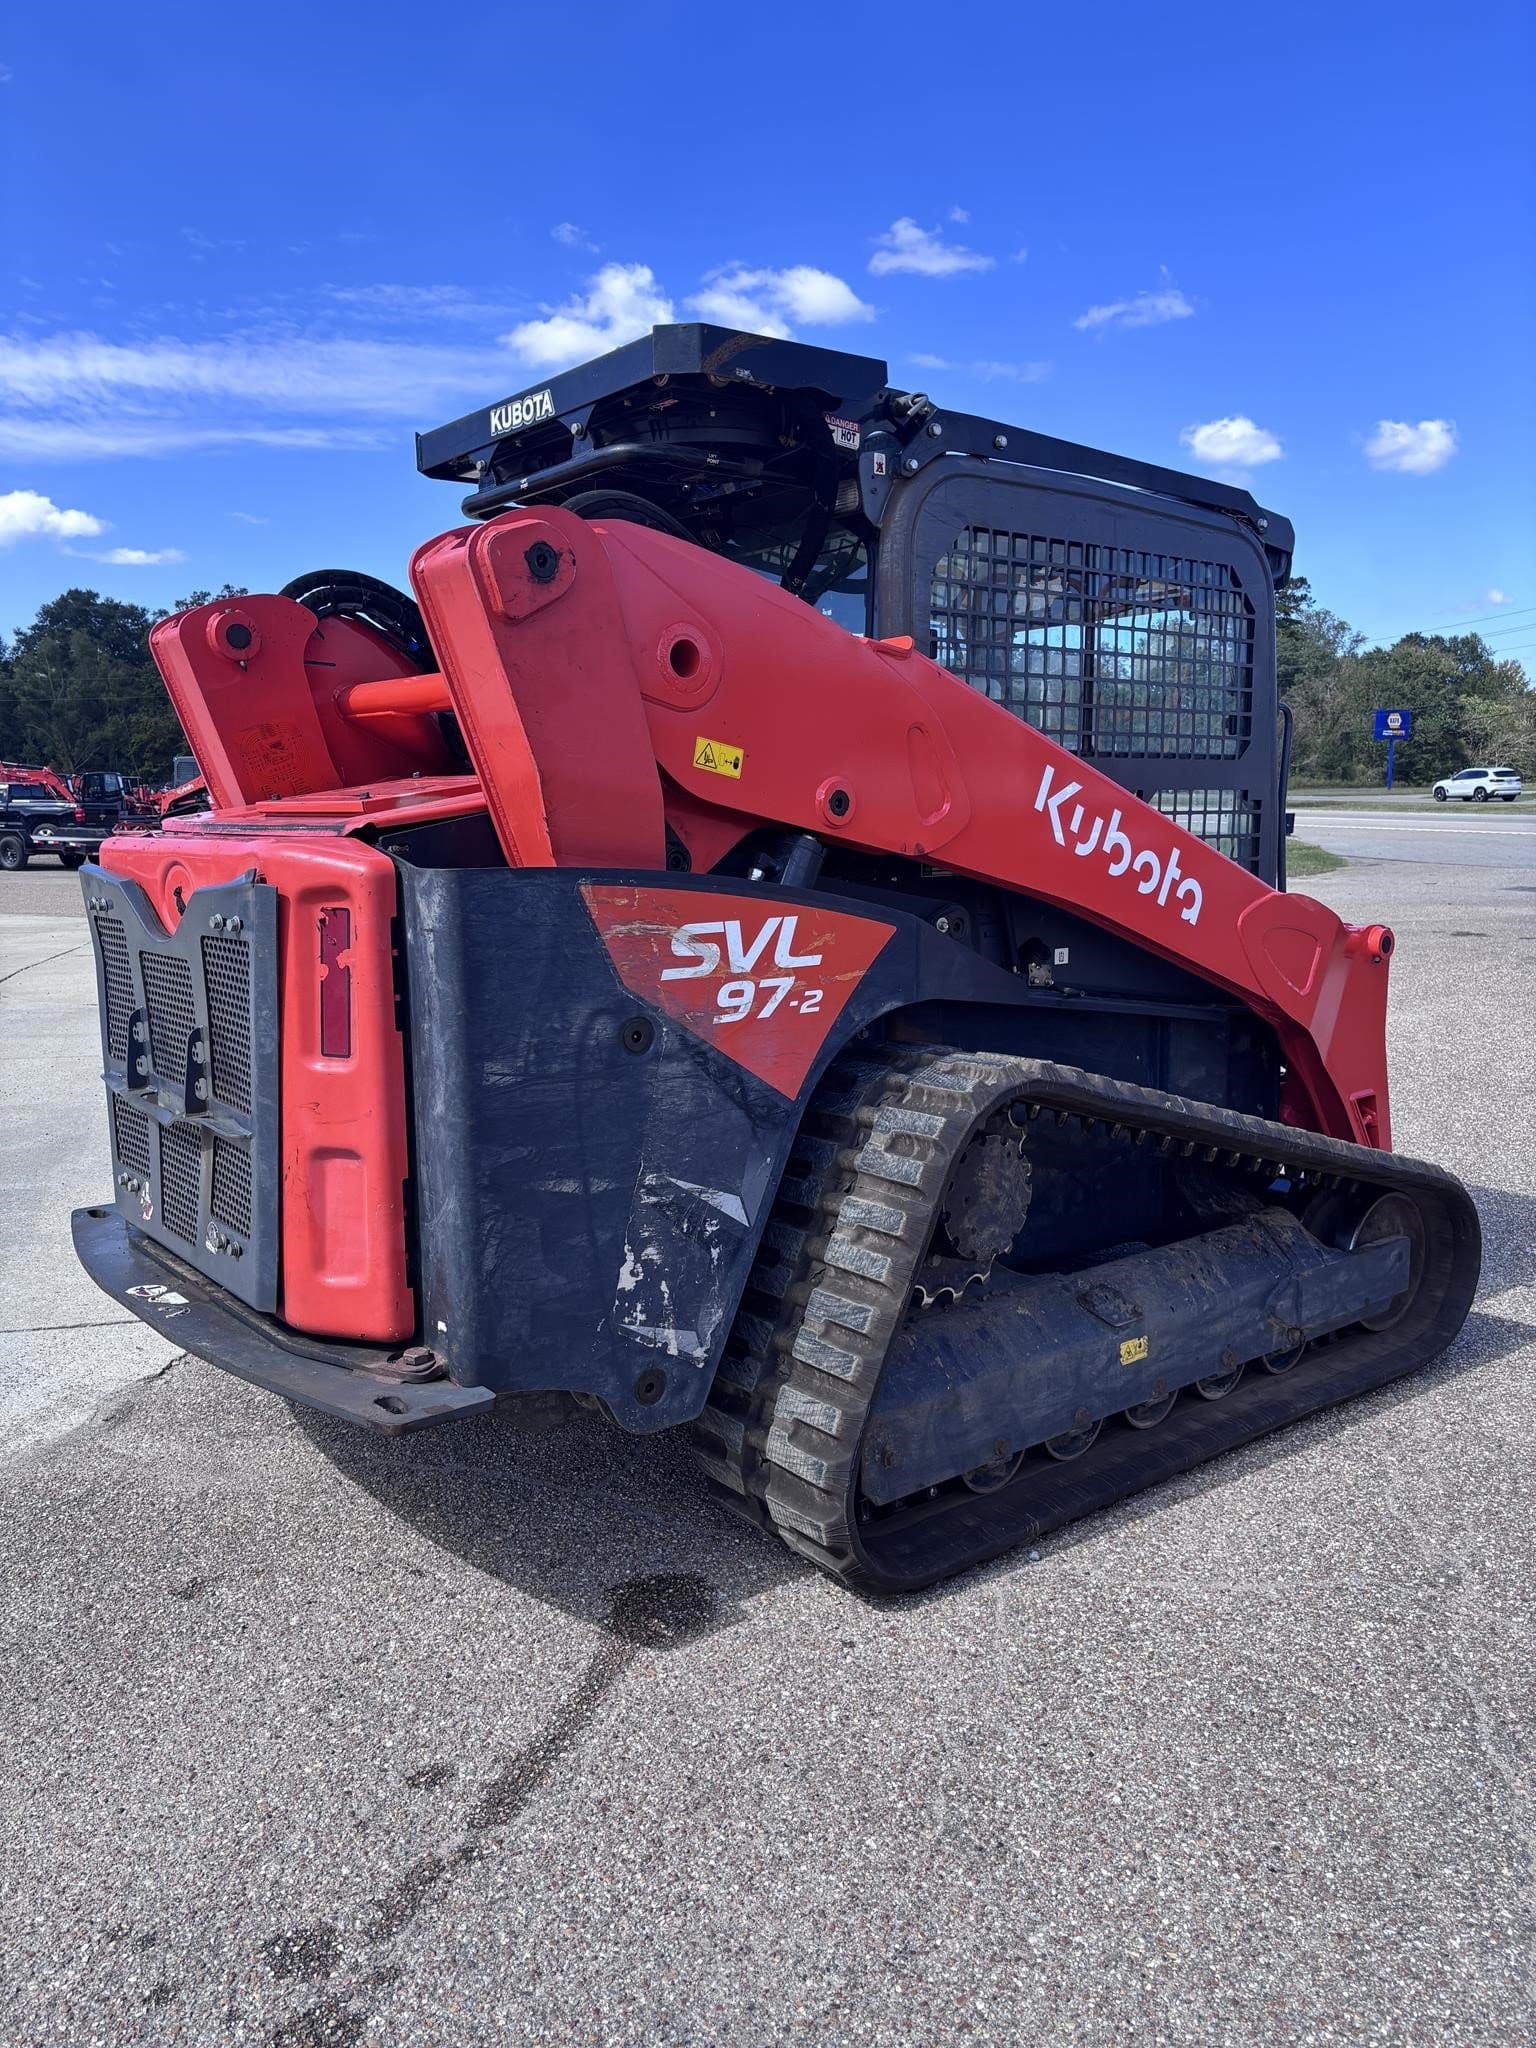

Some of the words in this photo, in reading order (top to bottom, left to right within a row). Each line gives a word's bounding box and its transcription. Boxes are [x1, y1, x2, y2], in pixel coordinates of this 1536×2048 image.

[490, 389, 555, 436] KUBOTA
[830, 416, 859, 432] DANGER
[841, 429, 857, 444] HOT
[1034, 764, 1203, 926] Kubota
[661, 916, 822, 981] SVL
